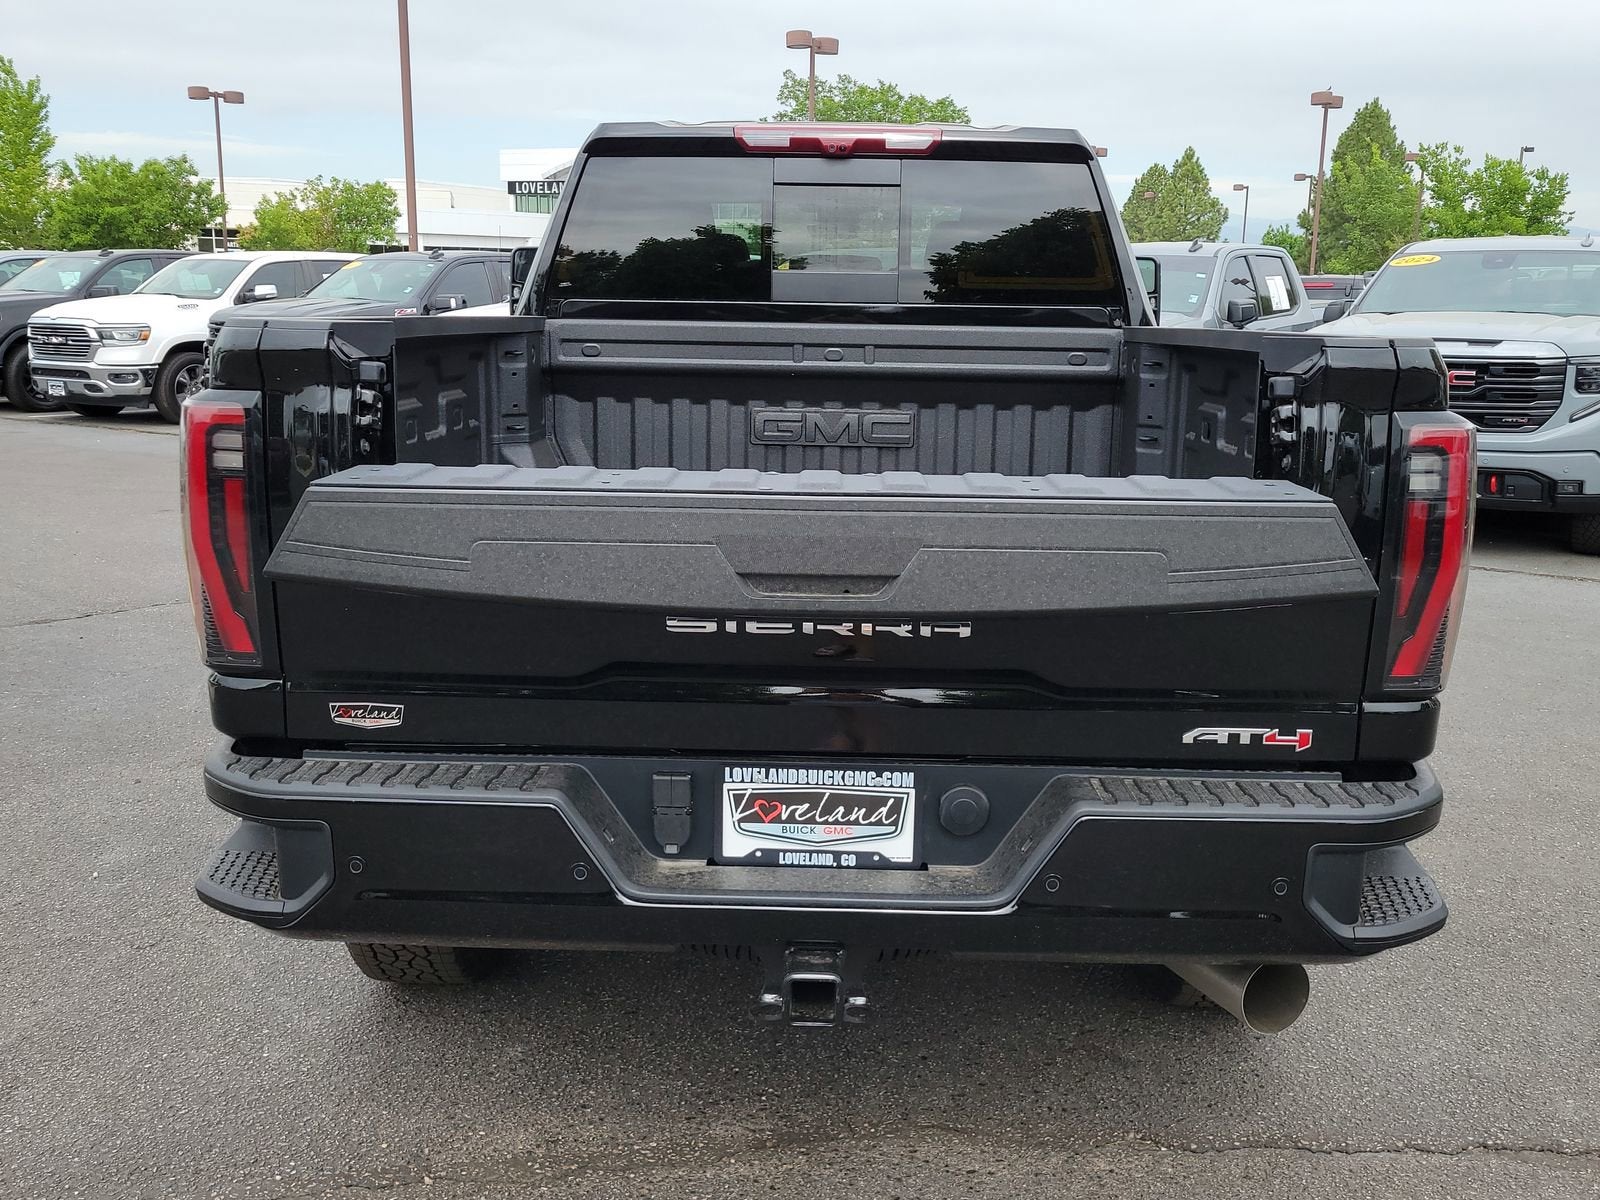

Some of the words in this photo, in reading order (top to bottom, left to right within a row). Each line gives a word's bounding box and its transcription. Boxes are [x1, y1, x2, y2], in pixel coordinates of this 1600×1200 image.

[754, 411, 911, 444] GMC
[665, 616, 972, 637] SIERRA
[1182, 727, 1314, 752] AT4
[781, 825, 817, 835] BUICK
[823, 826, 854, 836] GMC
[778, 851, 837, 867] LOVELAND,
[840, 854, 857, 867] CO
